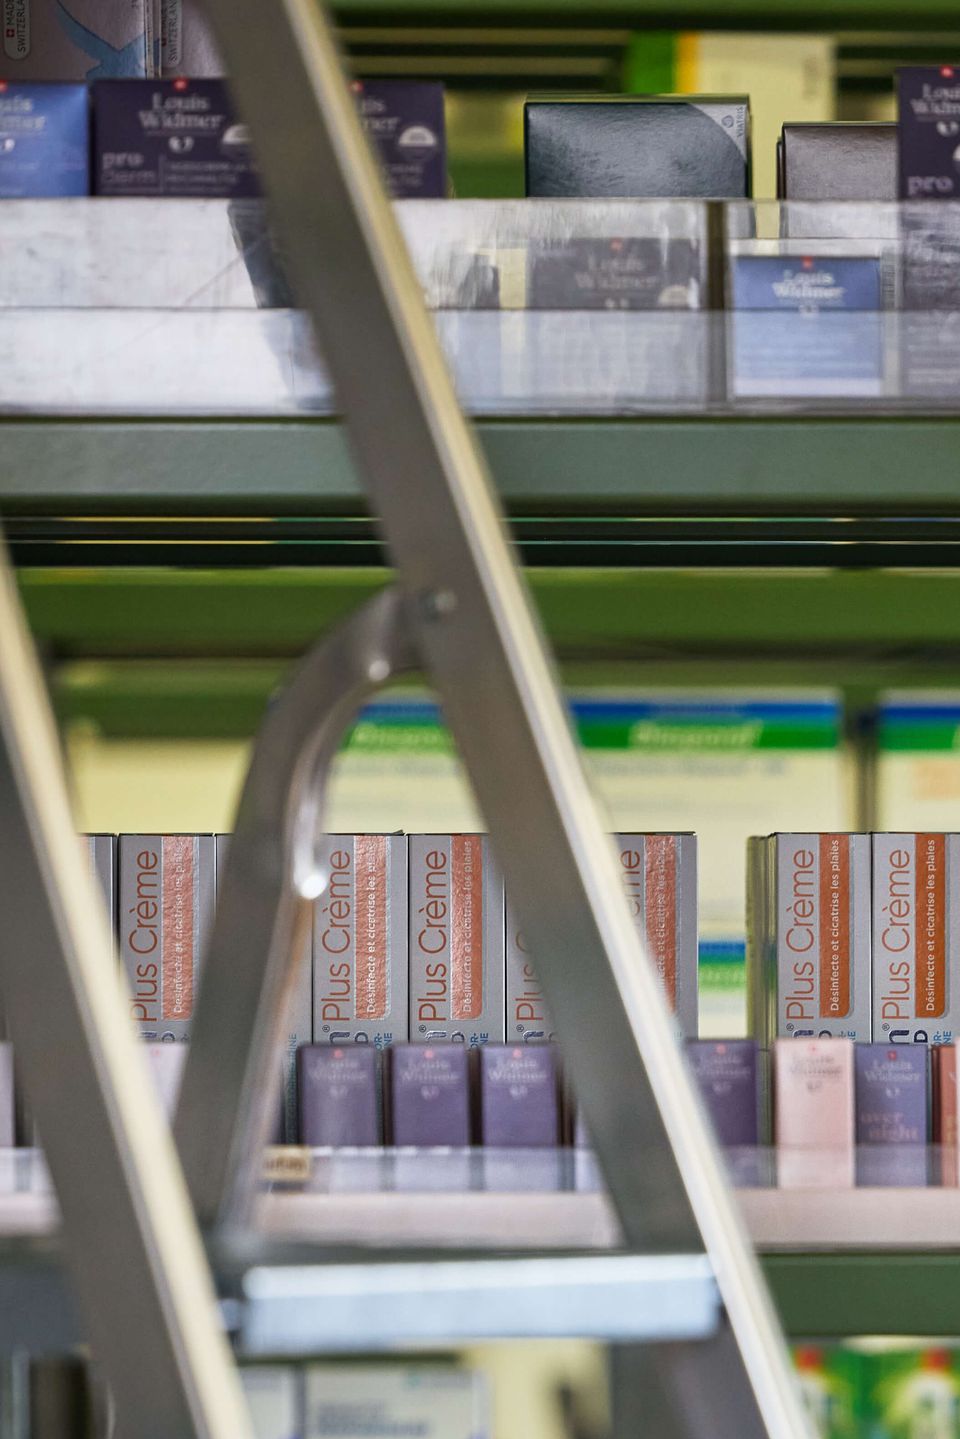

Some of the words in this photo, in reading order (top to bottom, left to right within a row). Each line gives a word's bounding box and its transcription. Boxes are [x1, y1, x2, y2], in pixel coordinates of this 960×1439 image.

[735, 104, 745, 138] VIATRIS
[907, 176, 953, 195] pro
[926, 840, 937, 871] plaies
[926, 875, 935, 889] les
[129, 850, 158, 954] Crème
[322, 850, 350, 954] Crème
[418, 850, 447, 954] Crème
[786, 849, 814, 952] Crème
[881, 849, 910, 952] Crème
[926, 892, 935, 936] cicatrise
[926, 941, 935, 951] et
[322, 963, 350, 1021] Plus
[418, 963, 447, 1021] Plus
[786, 961, 814, 1019] Plus
[881, 961, 910, 1019] Plus
[926, 954, 935, 1011] Désinfecte
